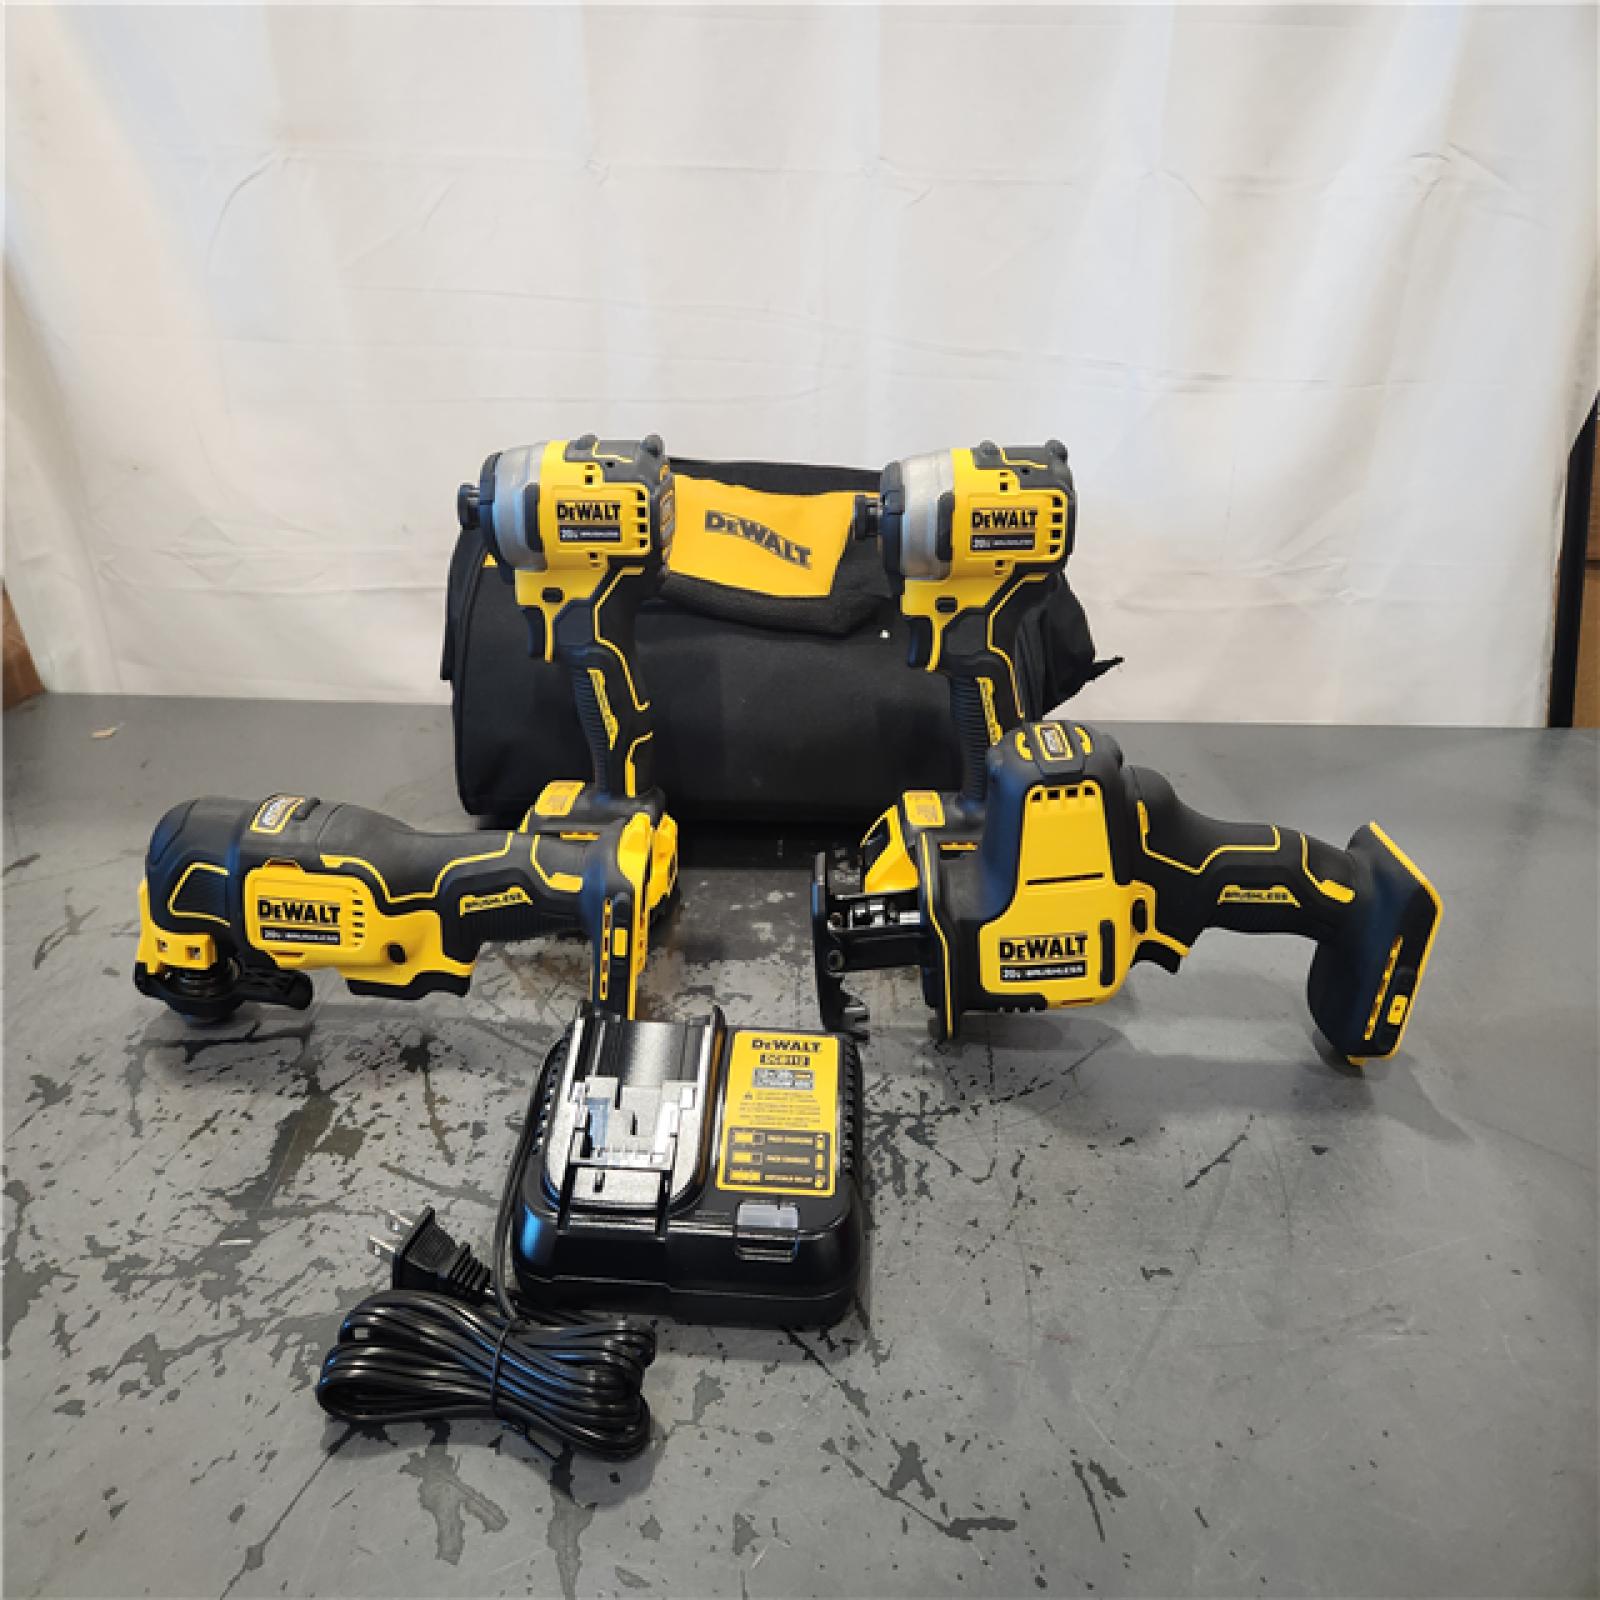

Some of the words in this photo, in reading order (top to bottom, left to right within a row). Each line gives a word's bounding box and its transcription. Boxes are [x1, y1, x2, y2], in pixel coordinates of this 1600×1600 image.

[557, 502, 621, 521] DEWALT
[972, 510, 1038, 529] DEWALT
[704, 509, 812, 569] DEWALT
[257, 898, 341, 924] DEWALT
[1000, 935, 1087, 960] DEWALT
[751, 1038, 821, 1053] DEWALT
